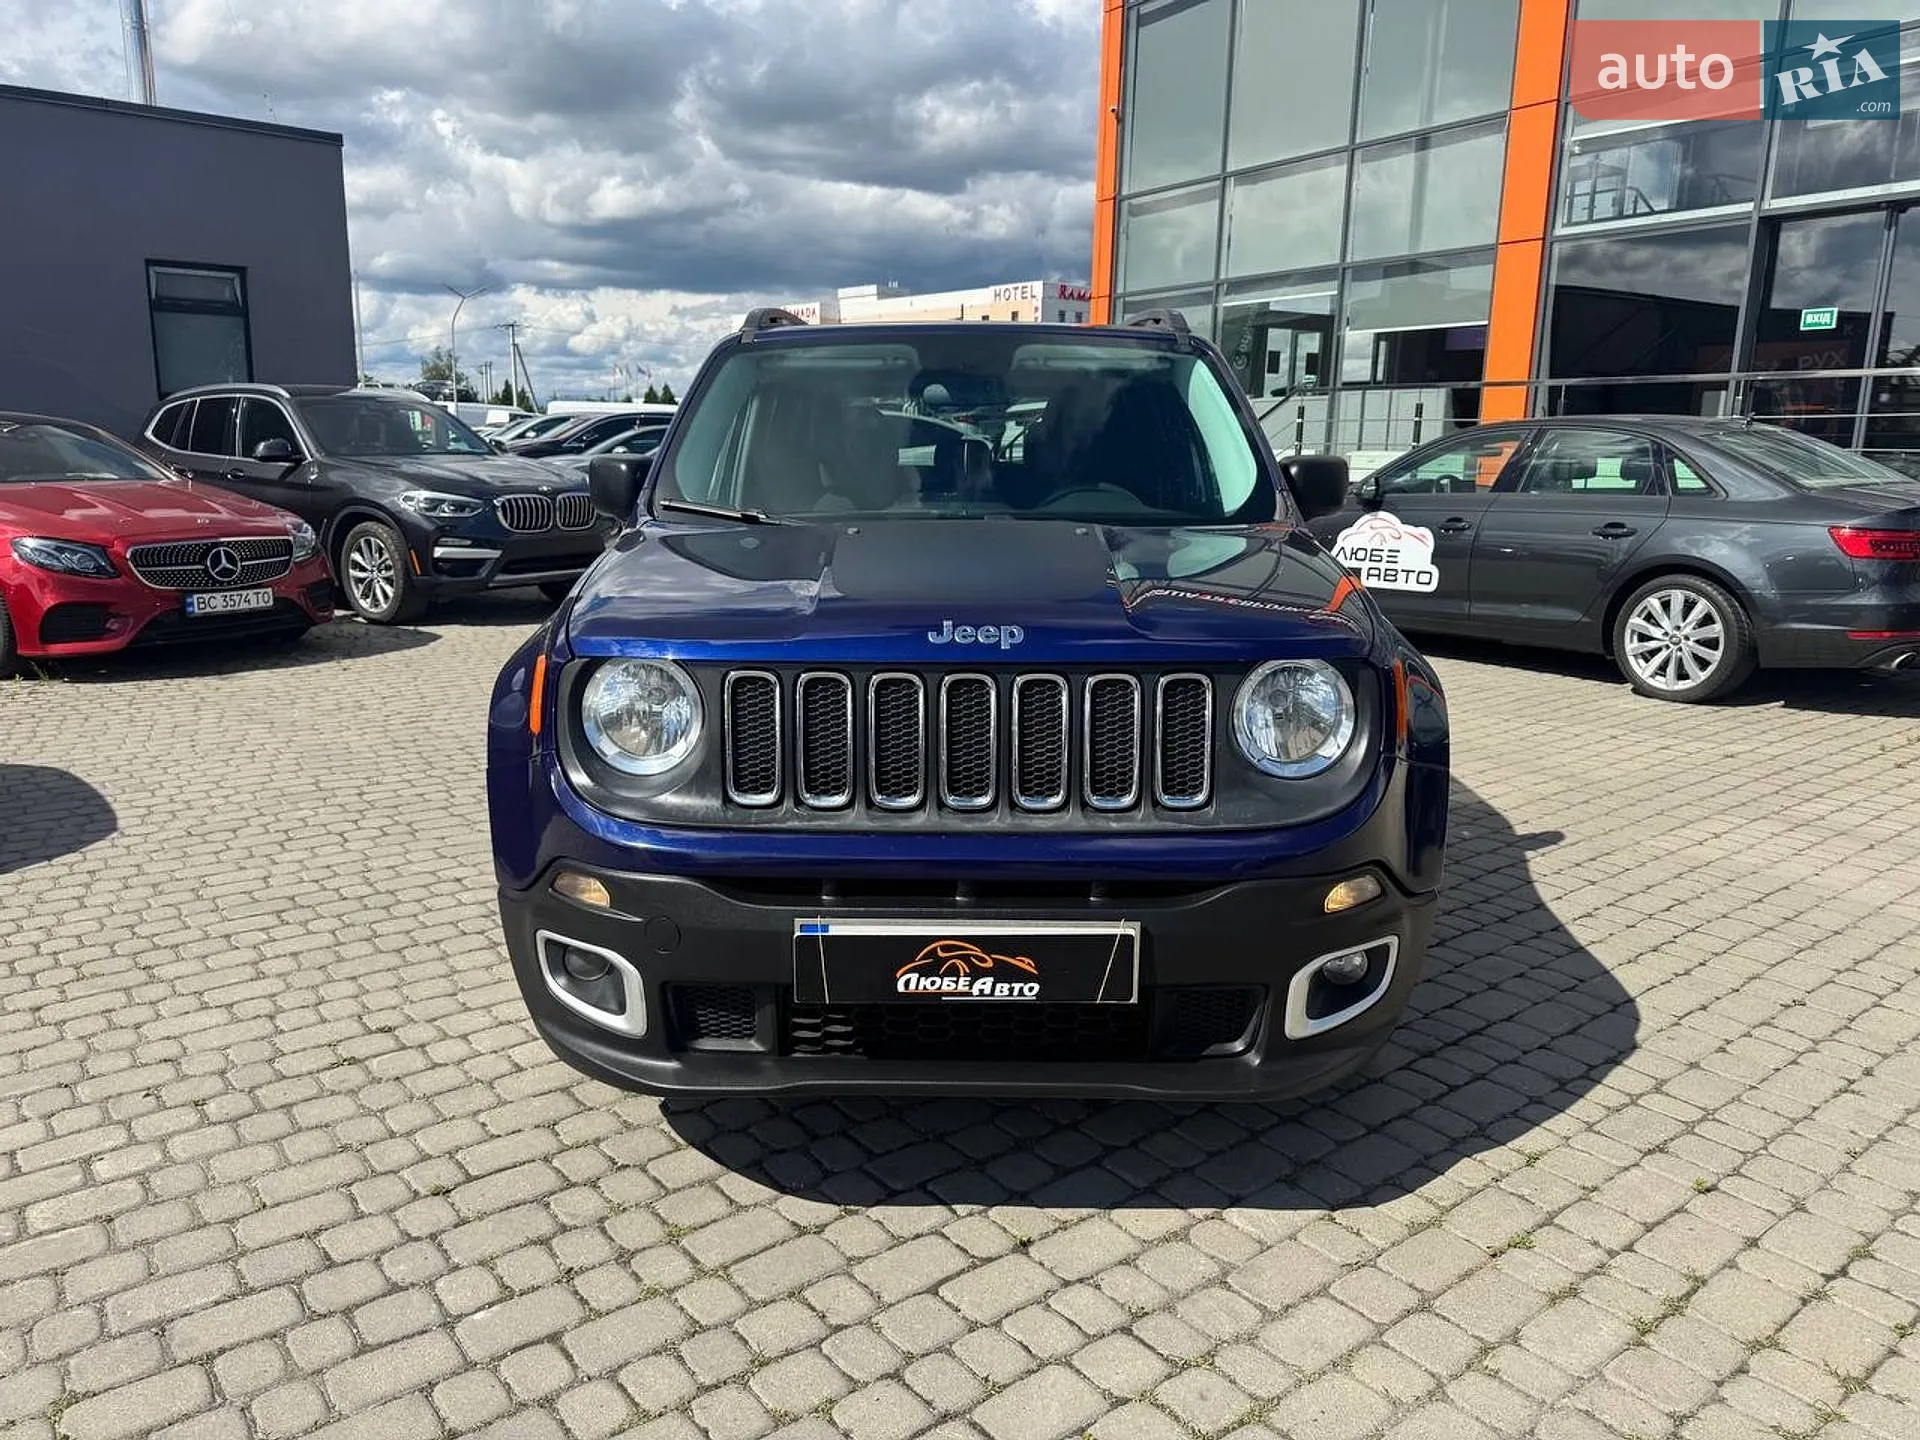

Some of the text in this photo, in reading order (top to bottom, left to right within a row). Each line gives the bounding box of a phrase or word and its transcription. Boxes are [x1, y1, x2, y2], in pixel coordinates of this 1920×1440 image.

[994, 284, 1037, 302] HOTEL
[1335, 546, 1401, 564] ЛЮБЕ
[1366, 567, 1433, 585] АВТО
[196, 591, 271, 611] BC 3574 TO
[928, 620, 1024, 649] Jeep
